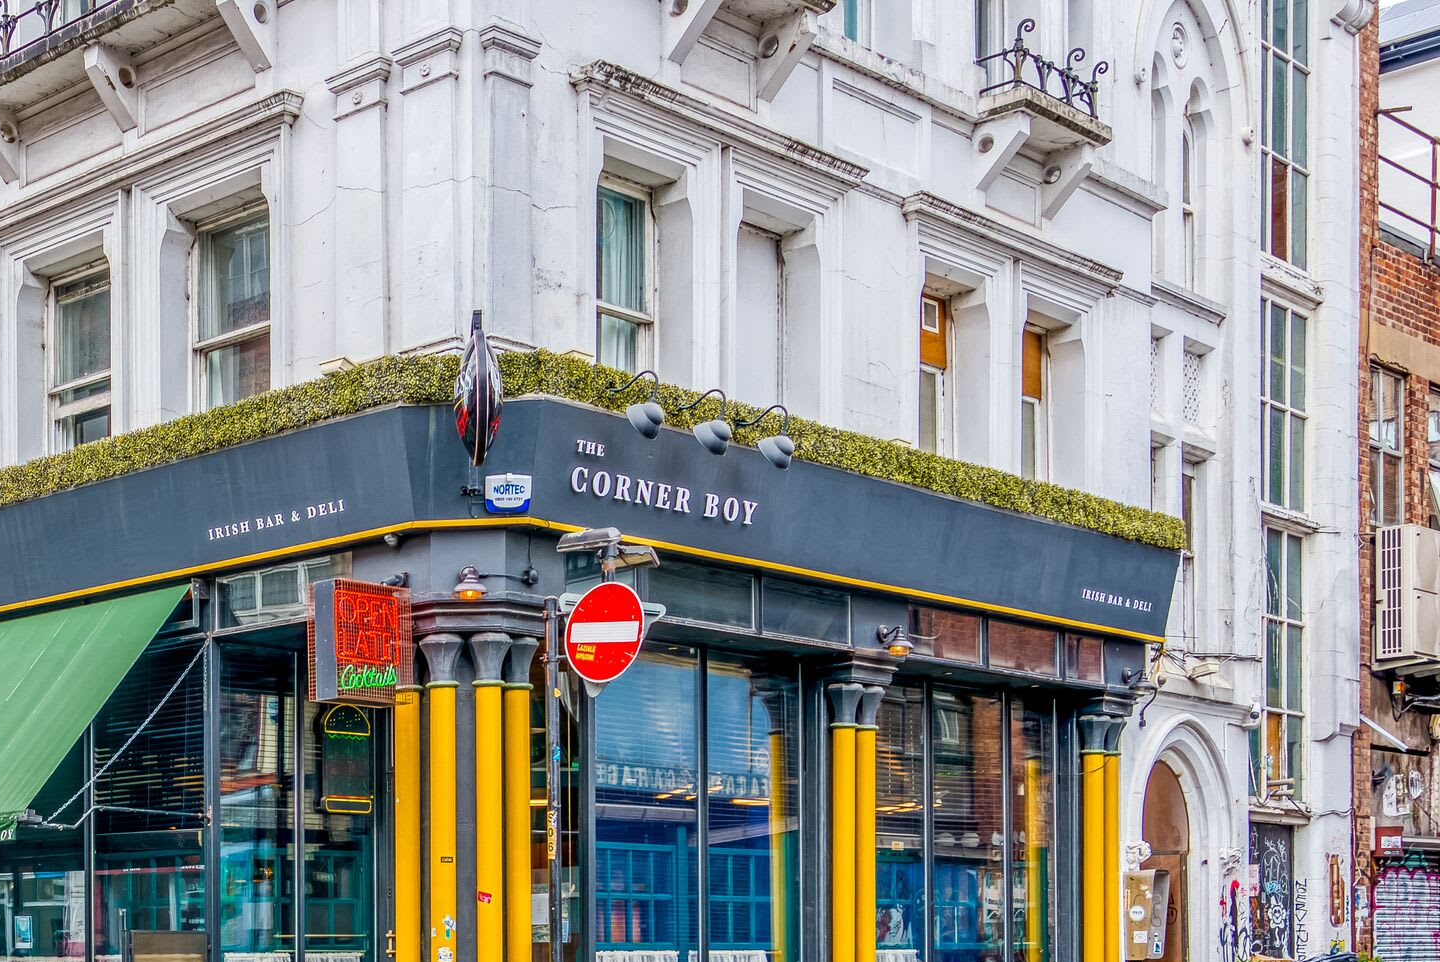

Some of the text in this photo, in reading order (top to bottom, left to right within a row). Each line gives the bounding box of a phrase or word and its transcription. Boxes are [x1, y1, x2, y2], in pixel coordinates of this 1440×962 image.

[577, 439, 605, 457] THE
[493, 483, 525, 495] NORTEC
[571, 466, 758, 525] CORNER BOY
[208, 499, 345, 541] IRISH BAR & DELI
[339, 596, 397, 629] OPEN
[1082, 589, 1153, 612] IRISH BAR & DELI
[342, 628, 392, 661] LATE
[341, 664, 397, 690] Cocktails
